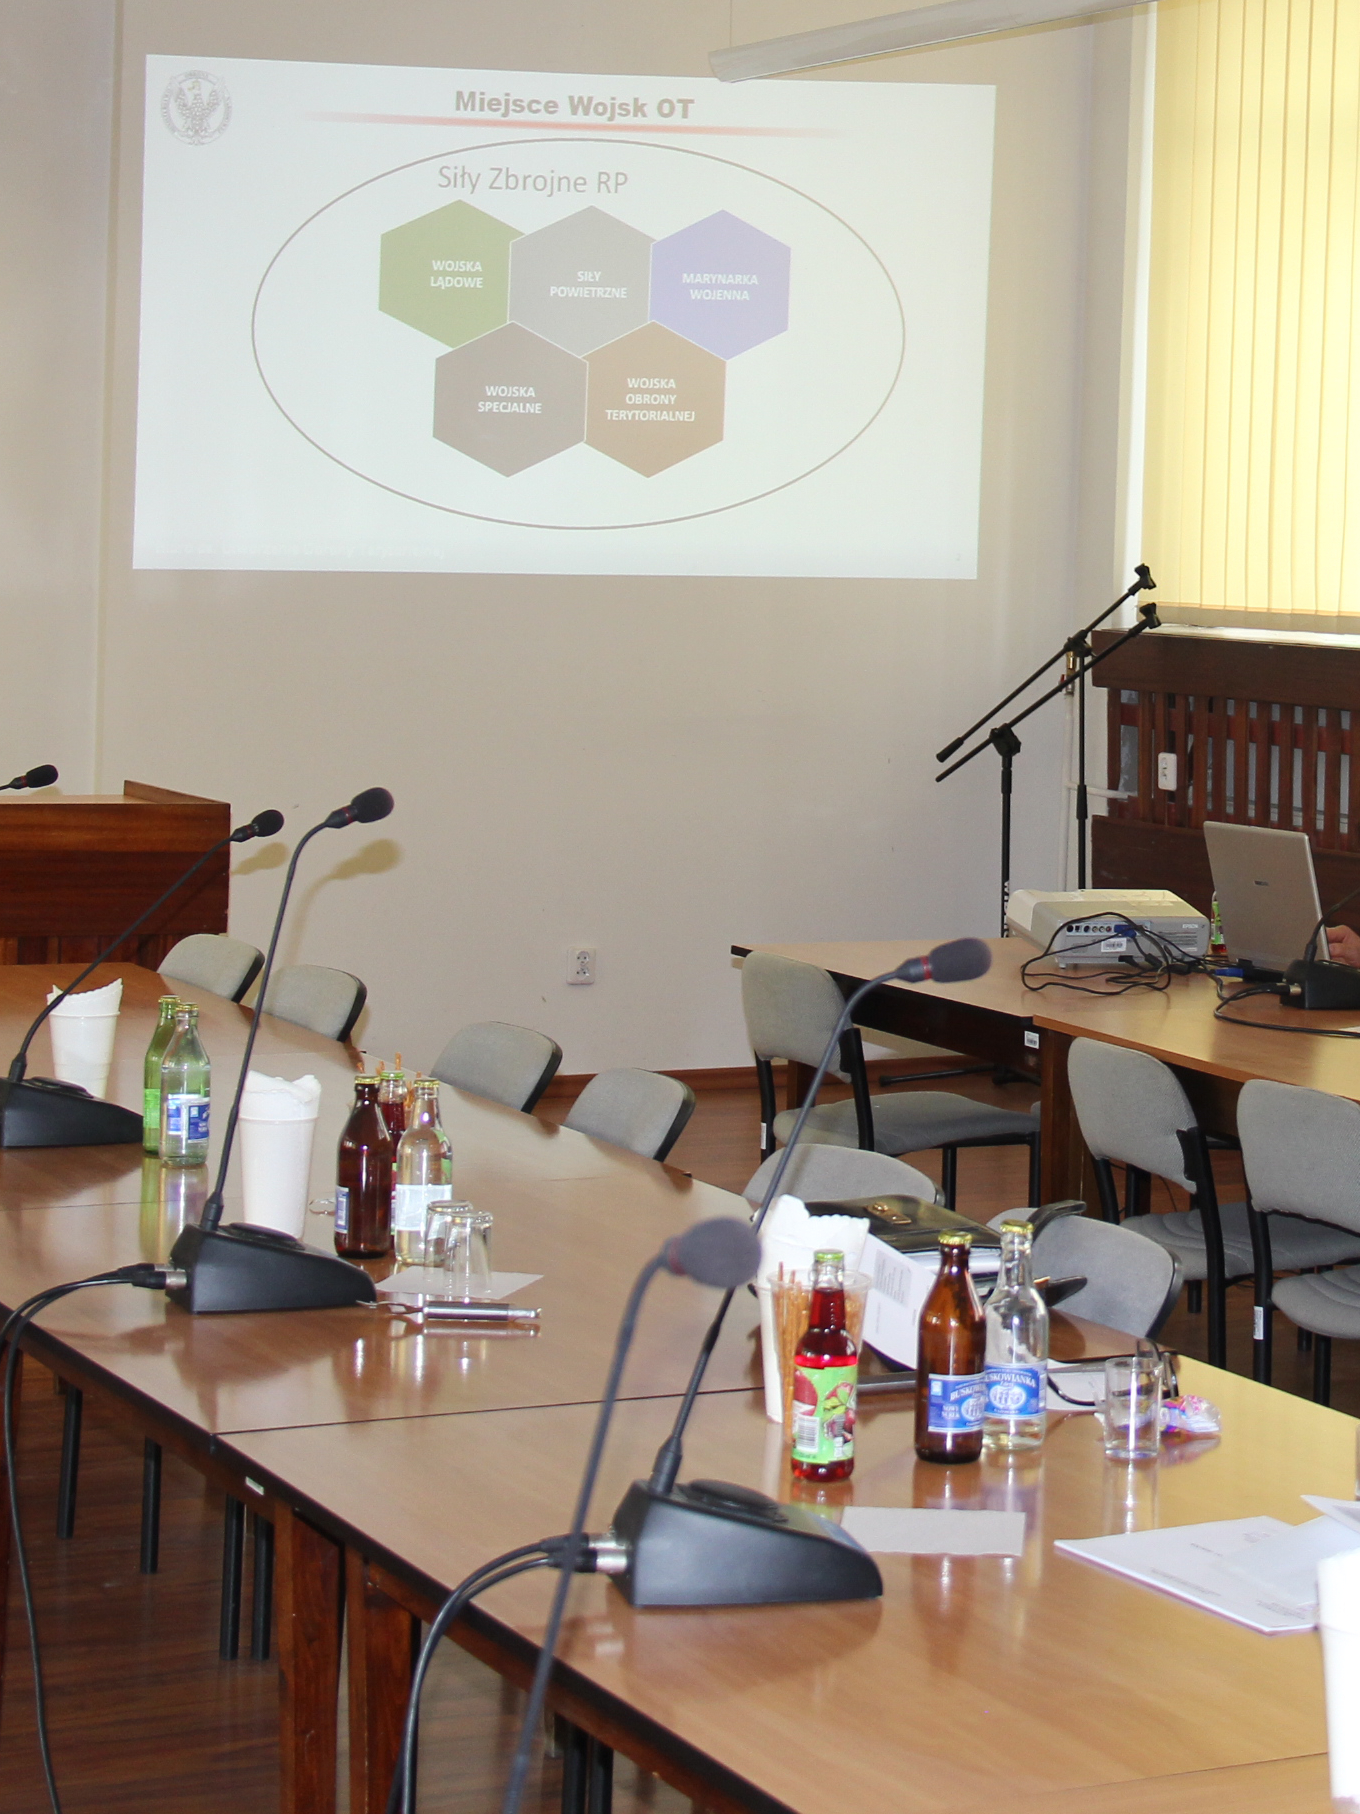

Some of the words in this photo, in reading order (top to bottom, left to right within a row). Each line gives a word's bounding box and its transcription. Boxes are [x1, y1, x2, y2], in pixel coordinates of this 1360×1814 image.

[455, 90, 559, 118] Miejsce
[568, 95, 648, 121] Wojsk
[656, 98, 695, 119] OT
[438, 165, 481, 194] Siły
[489, 166, 588, 197] Zbrojne
[597, 171, 628, 194] RP
[432, 260, 482, 272] WOJSKA
[430, 276, 484, 289] LĄDOWE
[577, 270, 602, 282] SIŁY
[682, 272, 759, 285] MARYNARKA
[550, 286, 627, 299] POWIETRZNE
[690, 289, 750, 301] WOJENNA
[627, 377, 676, 390] WOJSKA
[485, 385, 536, 398] WOJSKA
[626, 393, 677, 405] OBRONY
[478, 401, 543, 414] SPECJALNE
[605, 409, 696, 422] TERYTORIALNEJ
